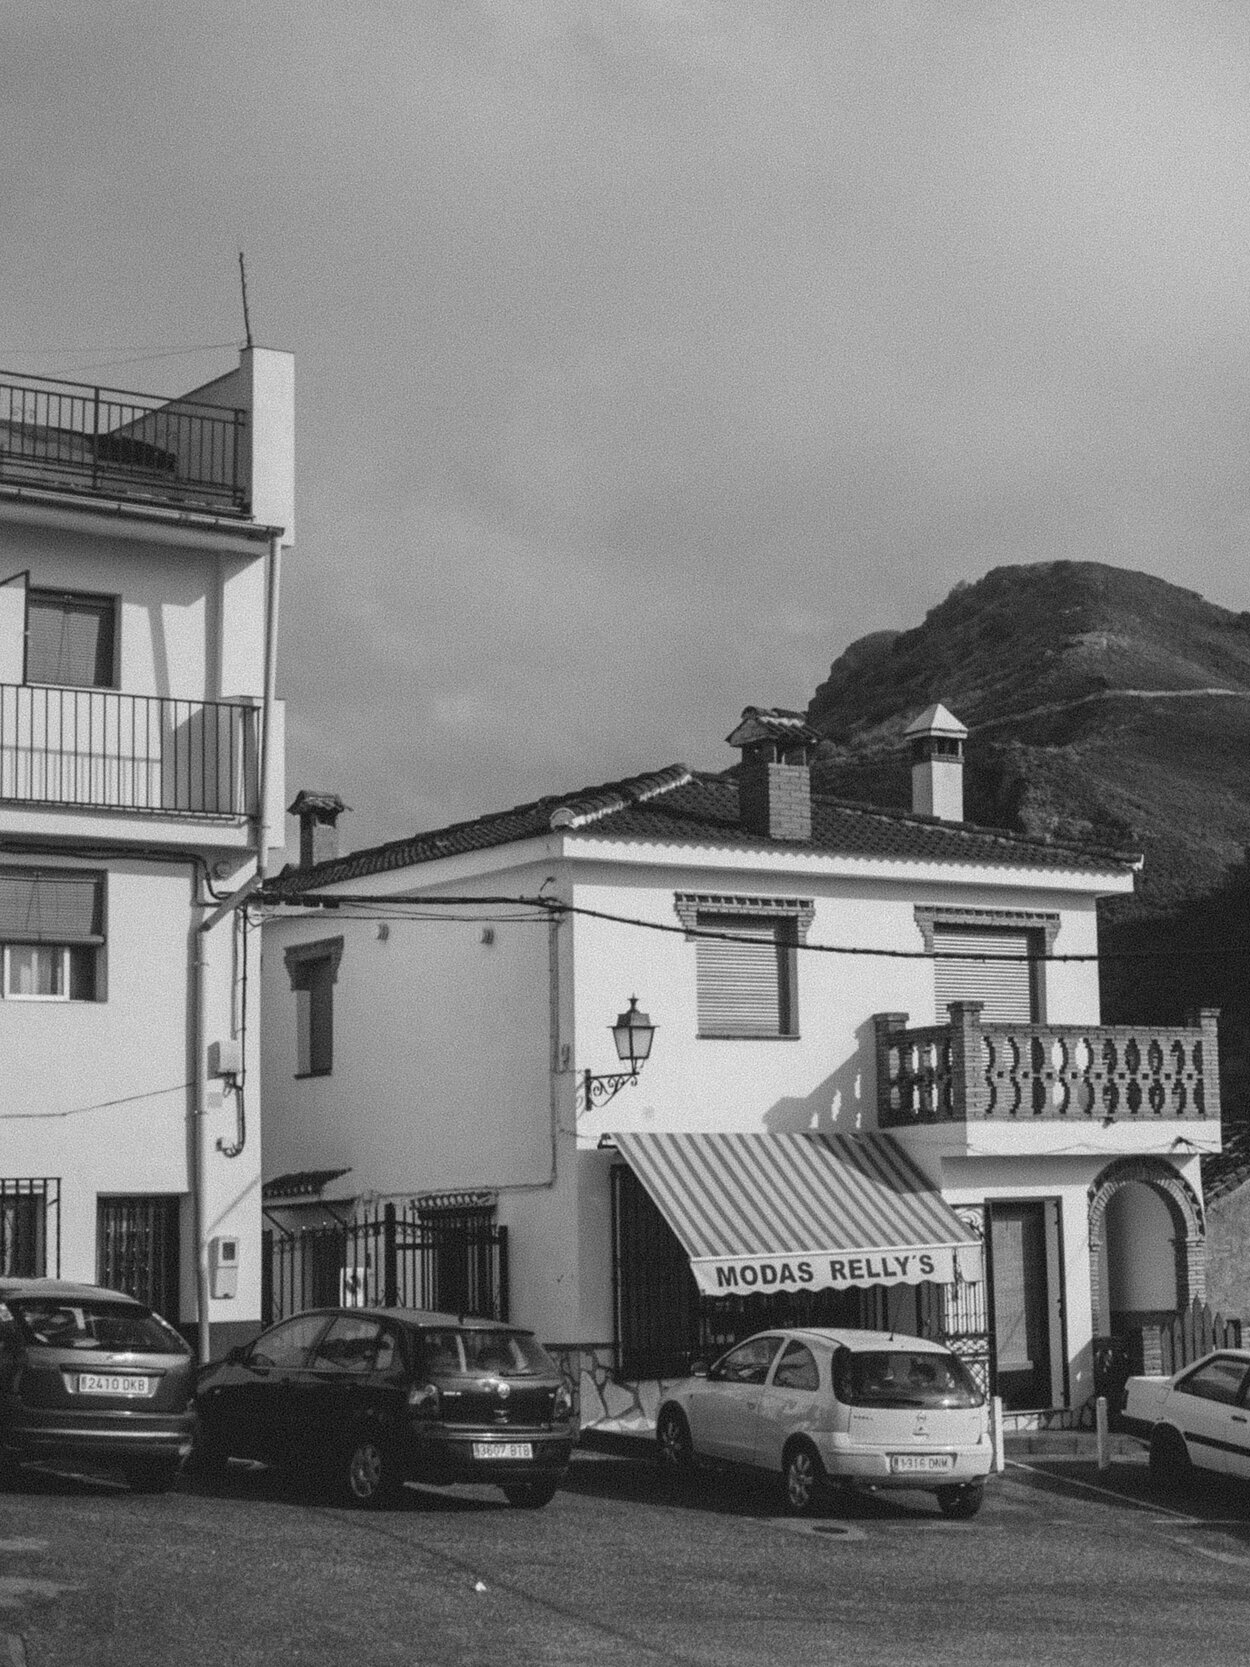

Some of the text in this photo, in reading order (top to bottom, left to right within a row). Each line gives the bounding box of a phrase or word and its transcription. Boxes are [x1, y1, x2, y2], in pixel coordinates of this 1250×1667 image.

[715, 1254, 935, 1287] MODAS RELLY'S
[88, 1377, 145, 1391] 2410 DKB
